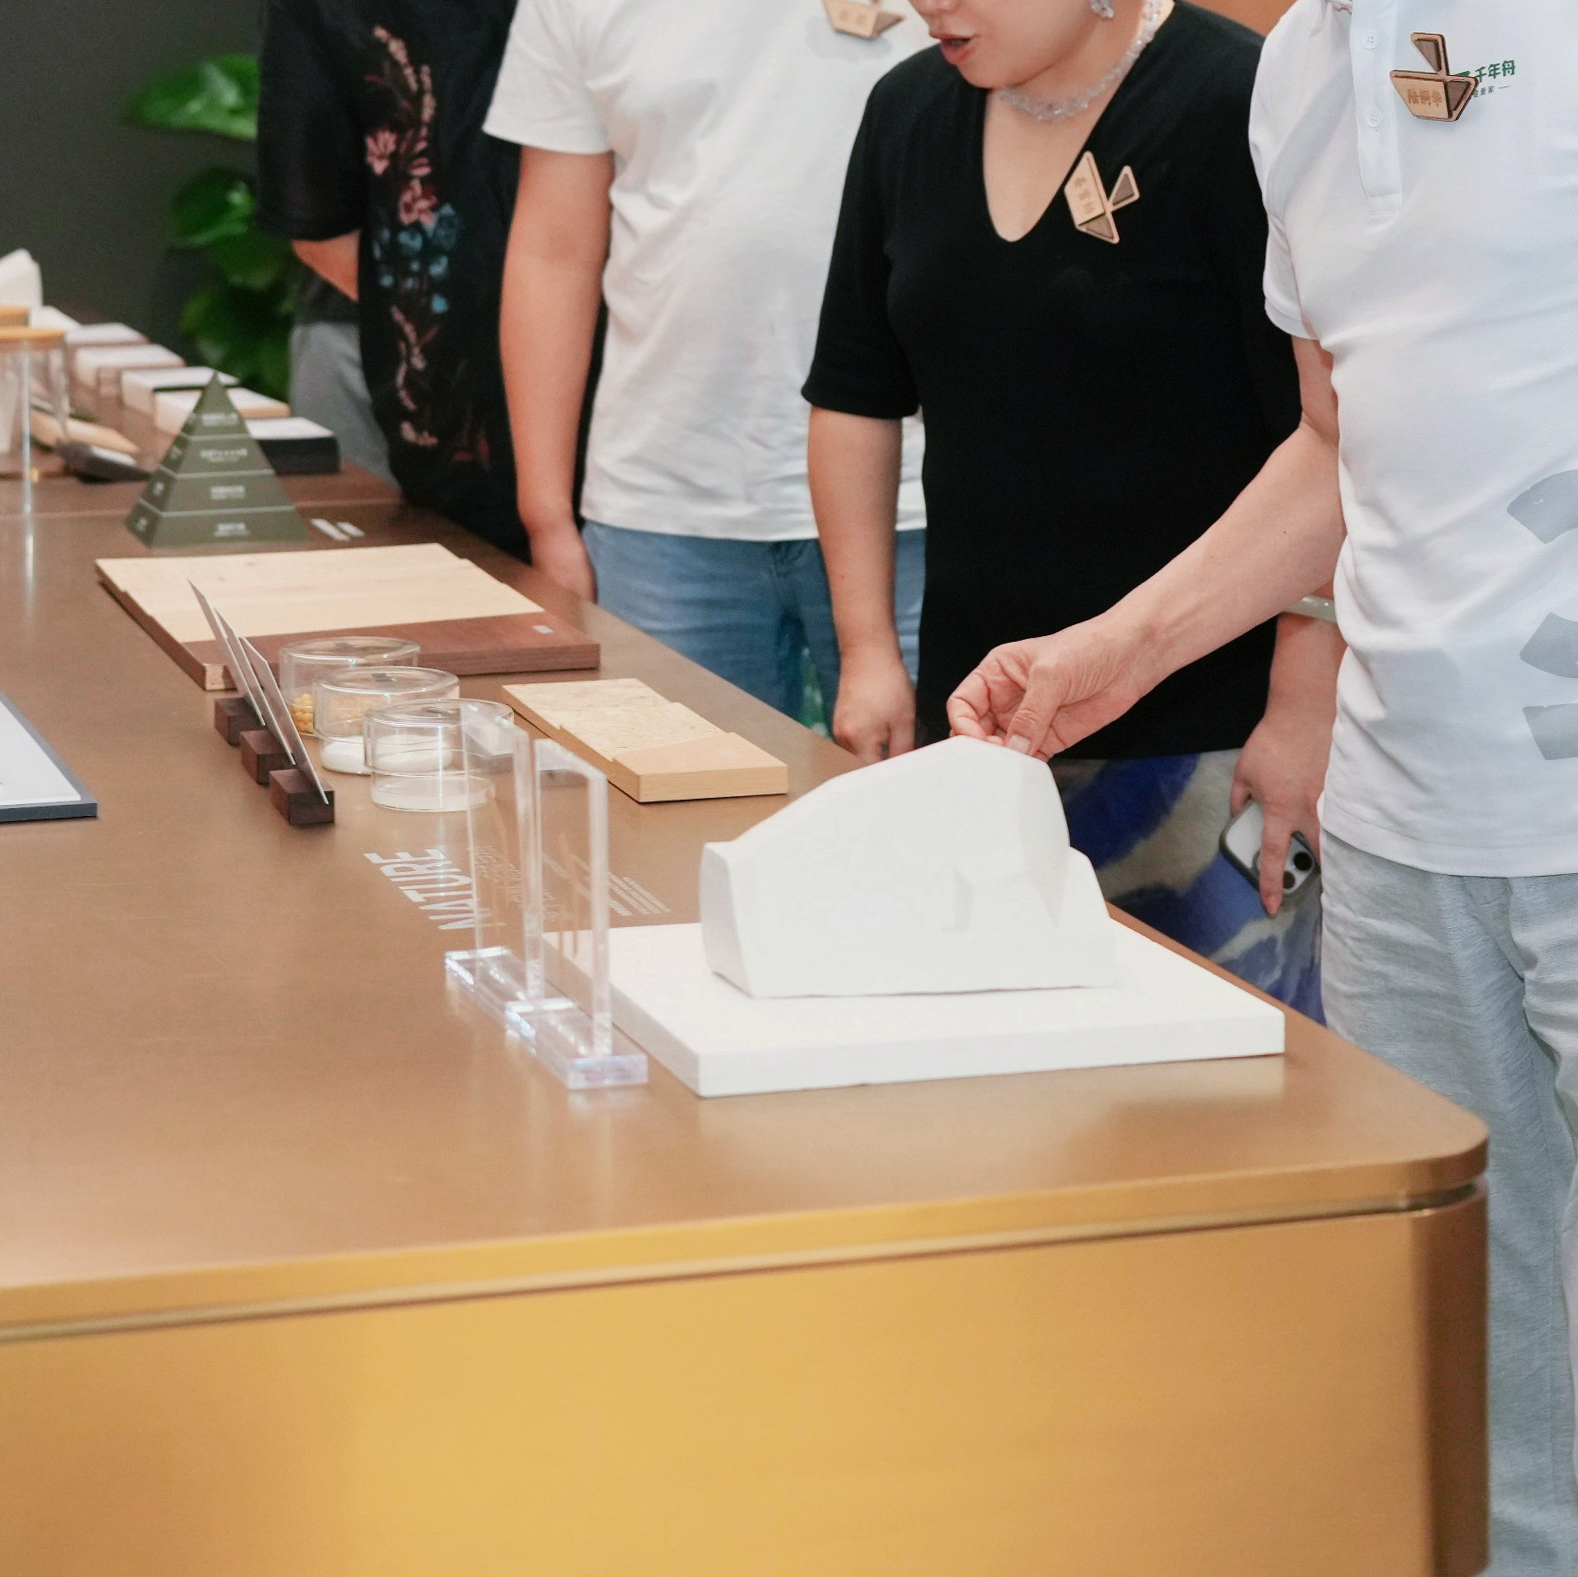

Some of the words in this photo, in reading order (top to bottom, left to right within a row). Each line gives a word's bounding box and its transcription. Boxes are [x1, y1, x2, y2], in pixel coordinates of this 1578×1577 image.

[1474, 59, 1516, 84] 千年舟
[363, 848, 507, 932] NATURE
